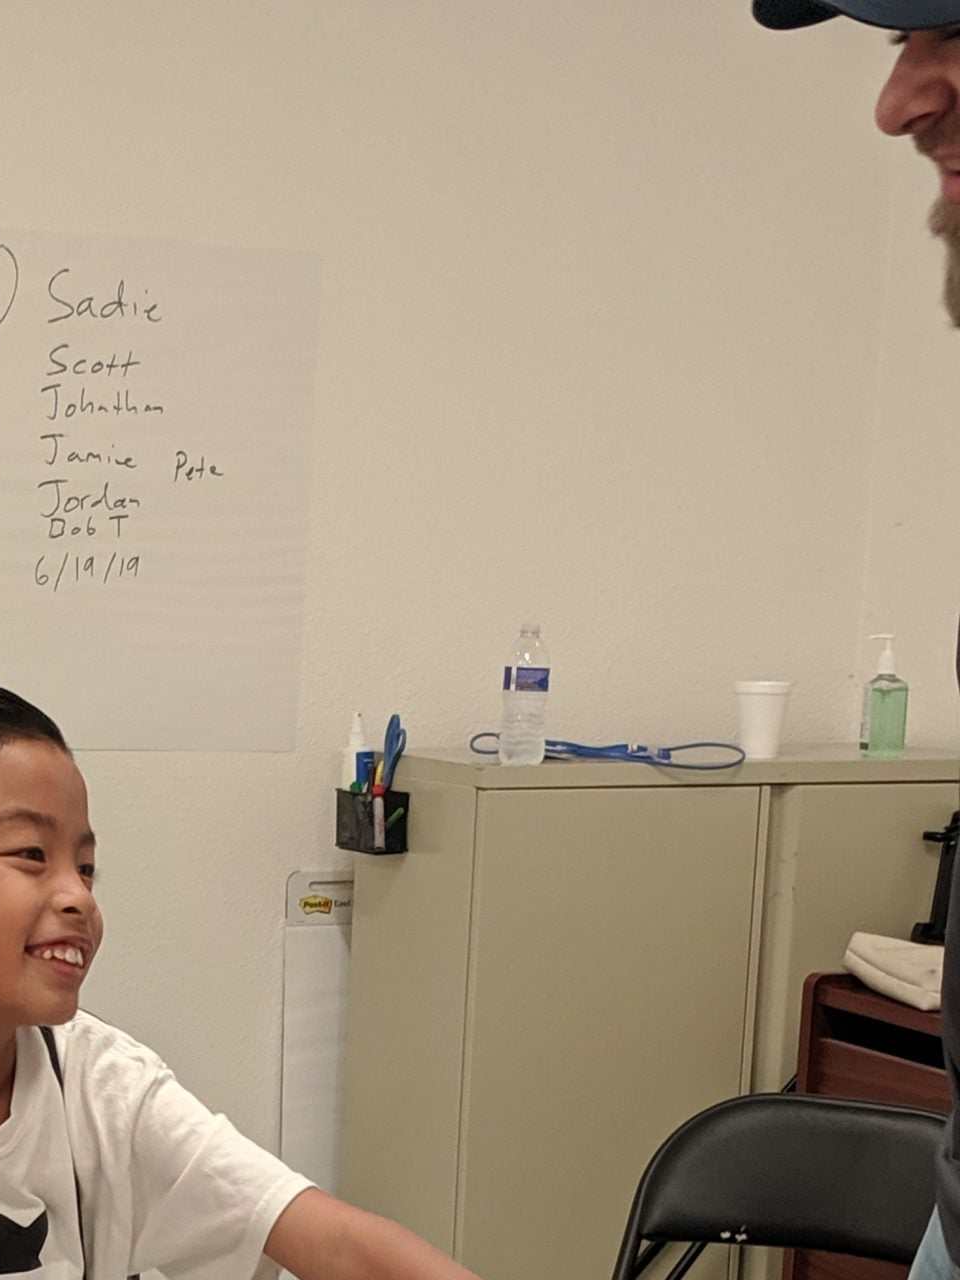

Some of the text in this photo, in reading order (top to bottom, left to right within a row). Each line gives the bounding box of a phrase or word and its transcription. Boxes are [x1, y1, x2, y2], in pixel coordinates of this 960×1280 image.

[47, 268, 162, 324] Sadie
[45, 343, 141, 377] Scott
[40, 433, 225, 482] Jamie Pete
[38, 479, 141, 518] Jordan
[109, 514, 130, 538] T
